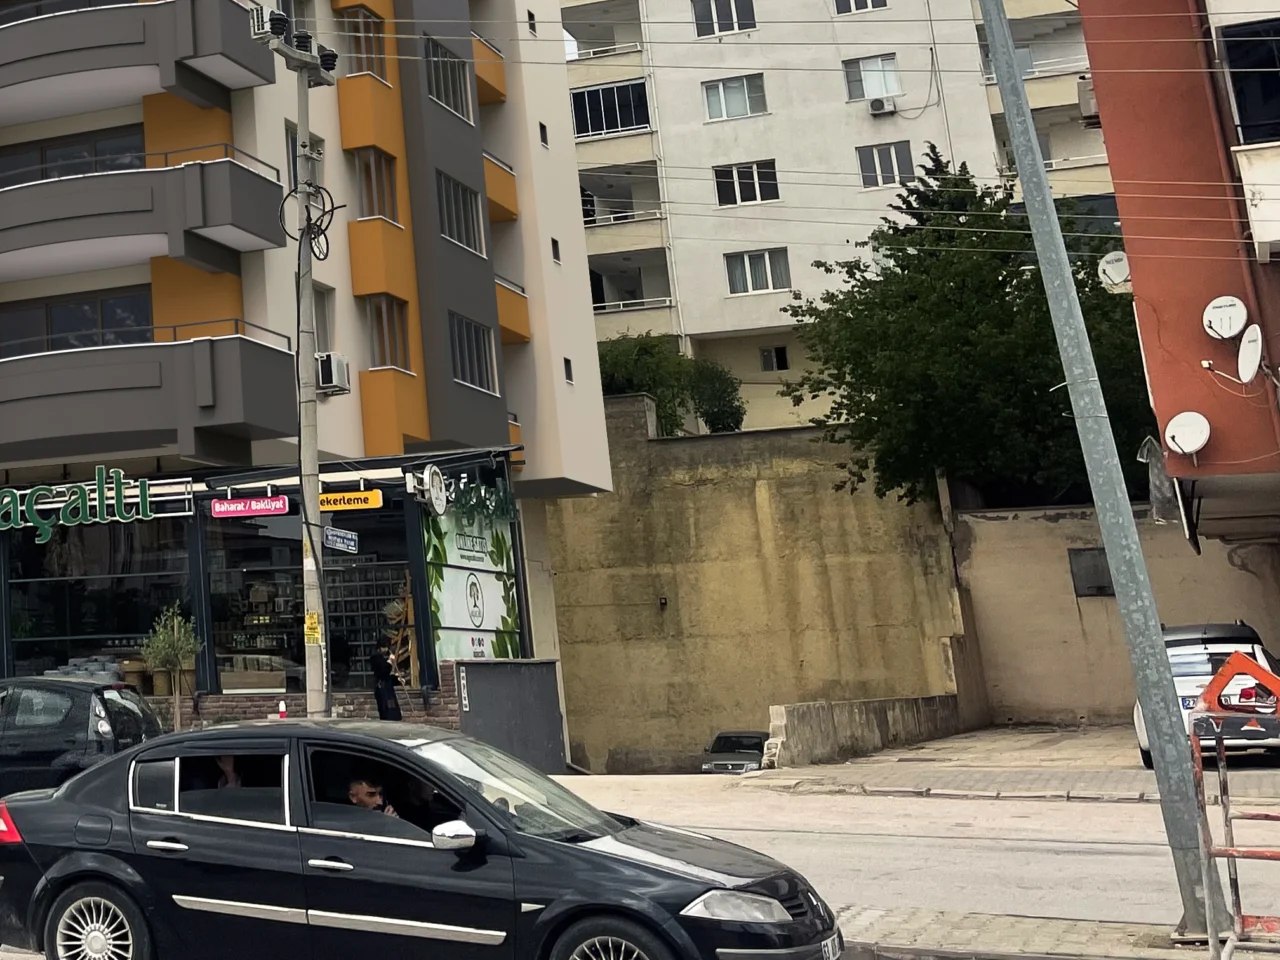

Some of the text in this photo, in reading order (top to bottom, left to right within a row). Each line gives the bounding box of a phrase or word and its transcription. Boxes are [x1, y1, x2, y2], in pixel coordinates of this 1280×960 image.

[214, 500, 245, 512] Baharat
[251, 498, 284, 511] Bakliyat
[320, 495, 369, 506] ekerleme
